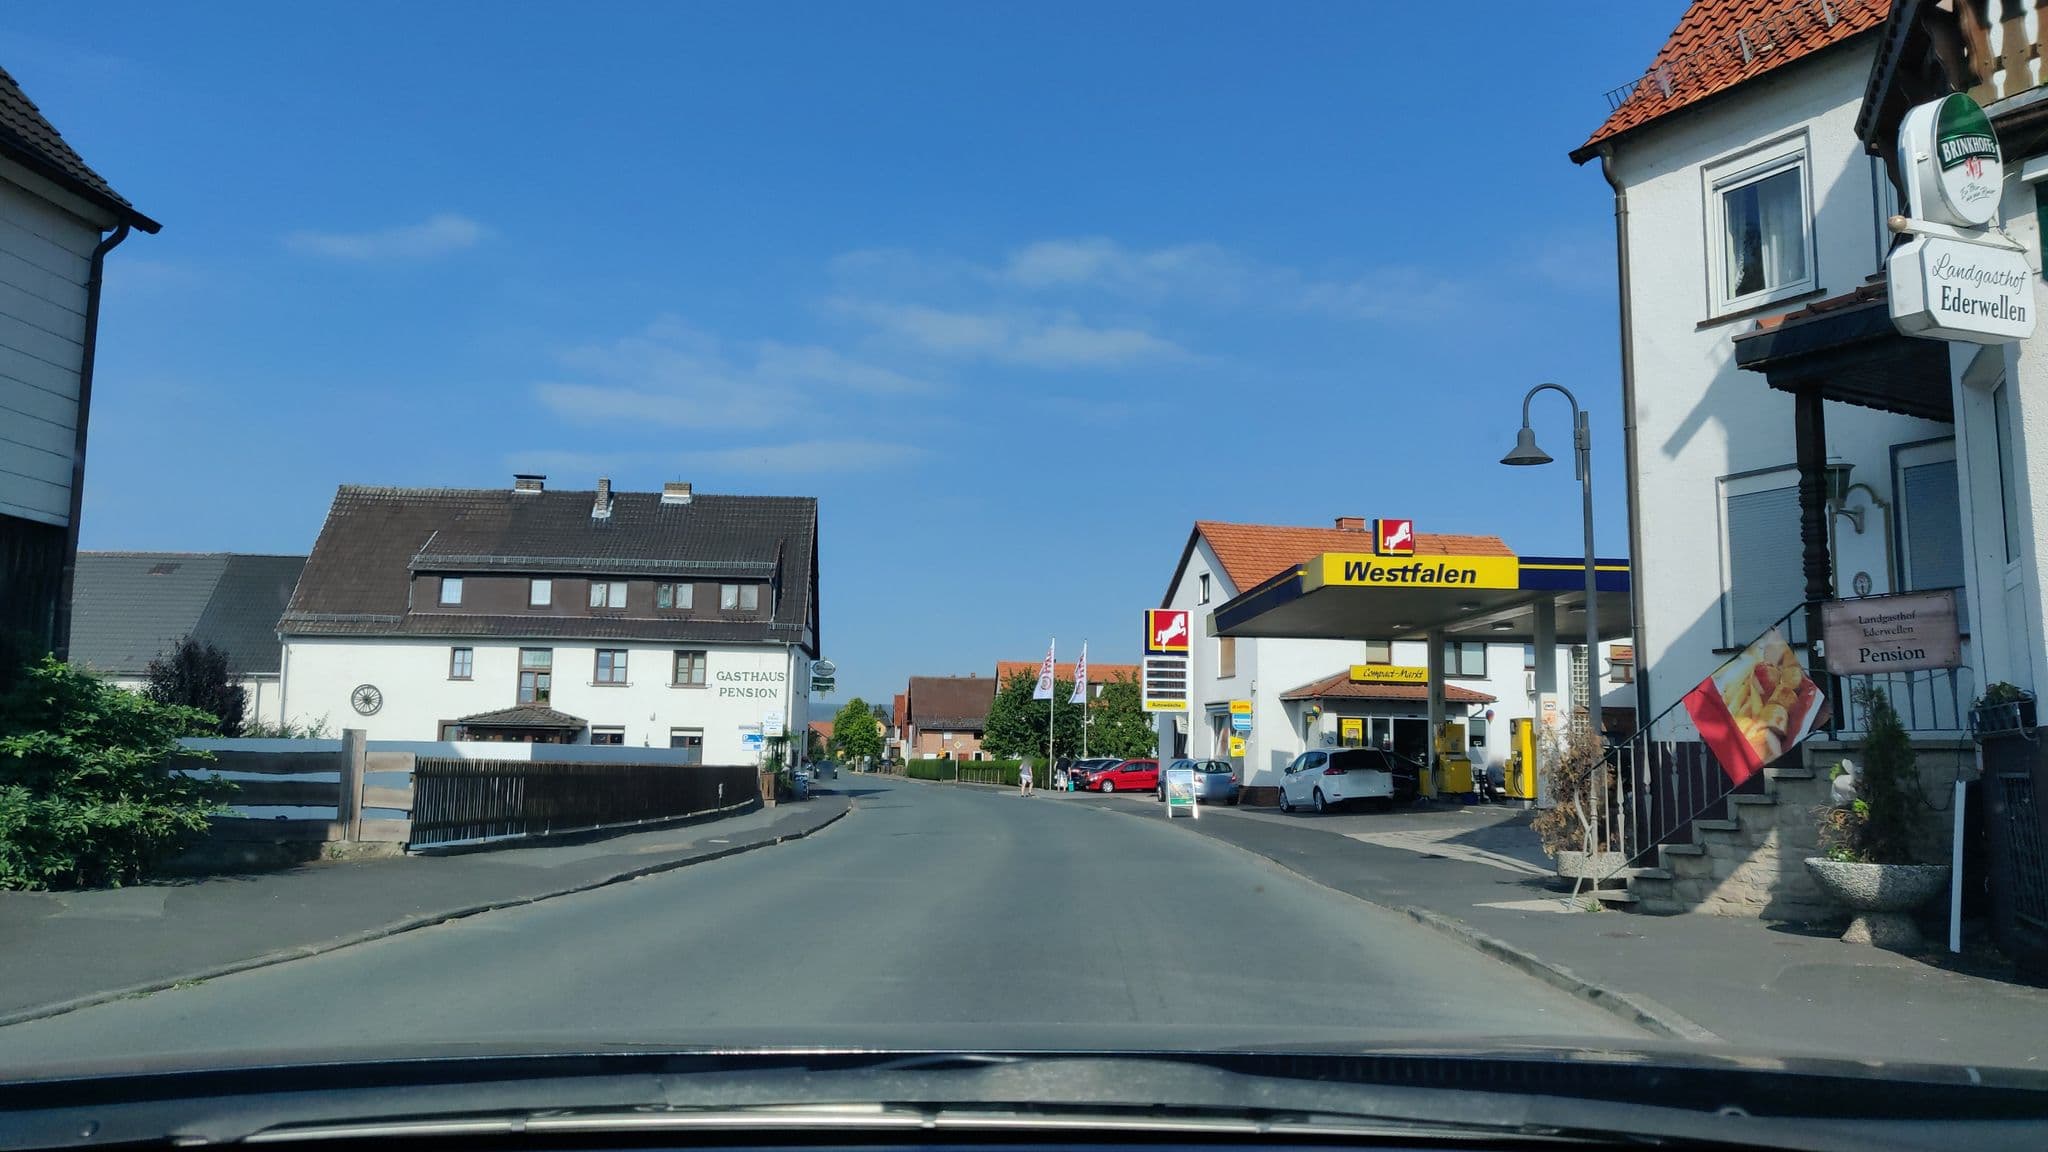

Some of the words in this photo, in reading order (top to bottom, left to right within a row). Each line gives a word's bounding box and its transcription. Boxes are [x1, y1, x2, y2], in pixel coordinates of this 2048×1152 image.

[1932, 253, 2027, 295] Landgasthof
[1941, 285, 2026, 322] Ederwellen
[1344, 561, 1477, 584] Westfalen
[1858, 610, 1916, 625] Landgasthof
[1863, 625, 1914, 638] Ederwellen
[1859, 646, 1925, 663] Pension
[716, 671, 785, 682] GASTHAUS
[719, 687, 778, 698] PENSION
